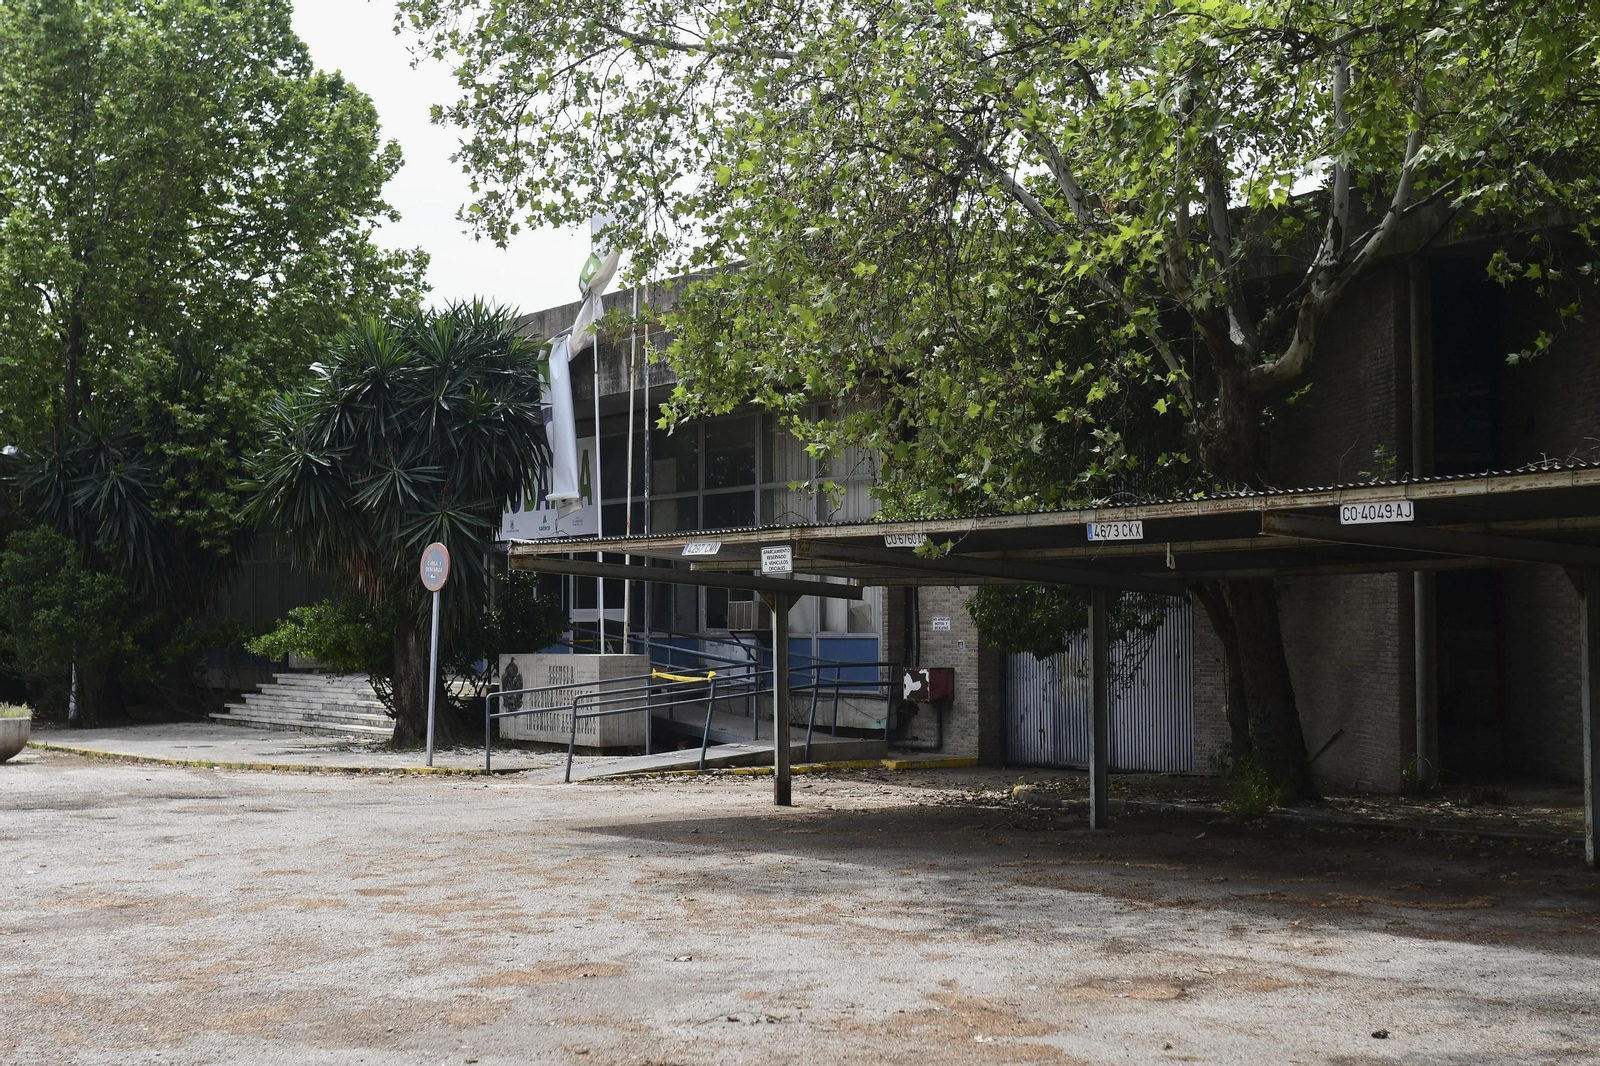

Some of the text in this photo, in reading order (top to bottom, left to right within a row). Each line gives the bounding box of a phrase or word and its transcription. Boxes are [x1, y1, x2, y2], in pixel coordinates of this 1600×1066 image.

[1094, 523, 1141, 537] 4673 CKX
[688, 543, 705, 553] 4297
[549, 666, 575, 685] ESCUELA
[562, 713, 597, 735] AGRNOMOS
